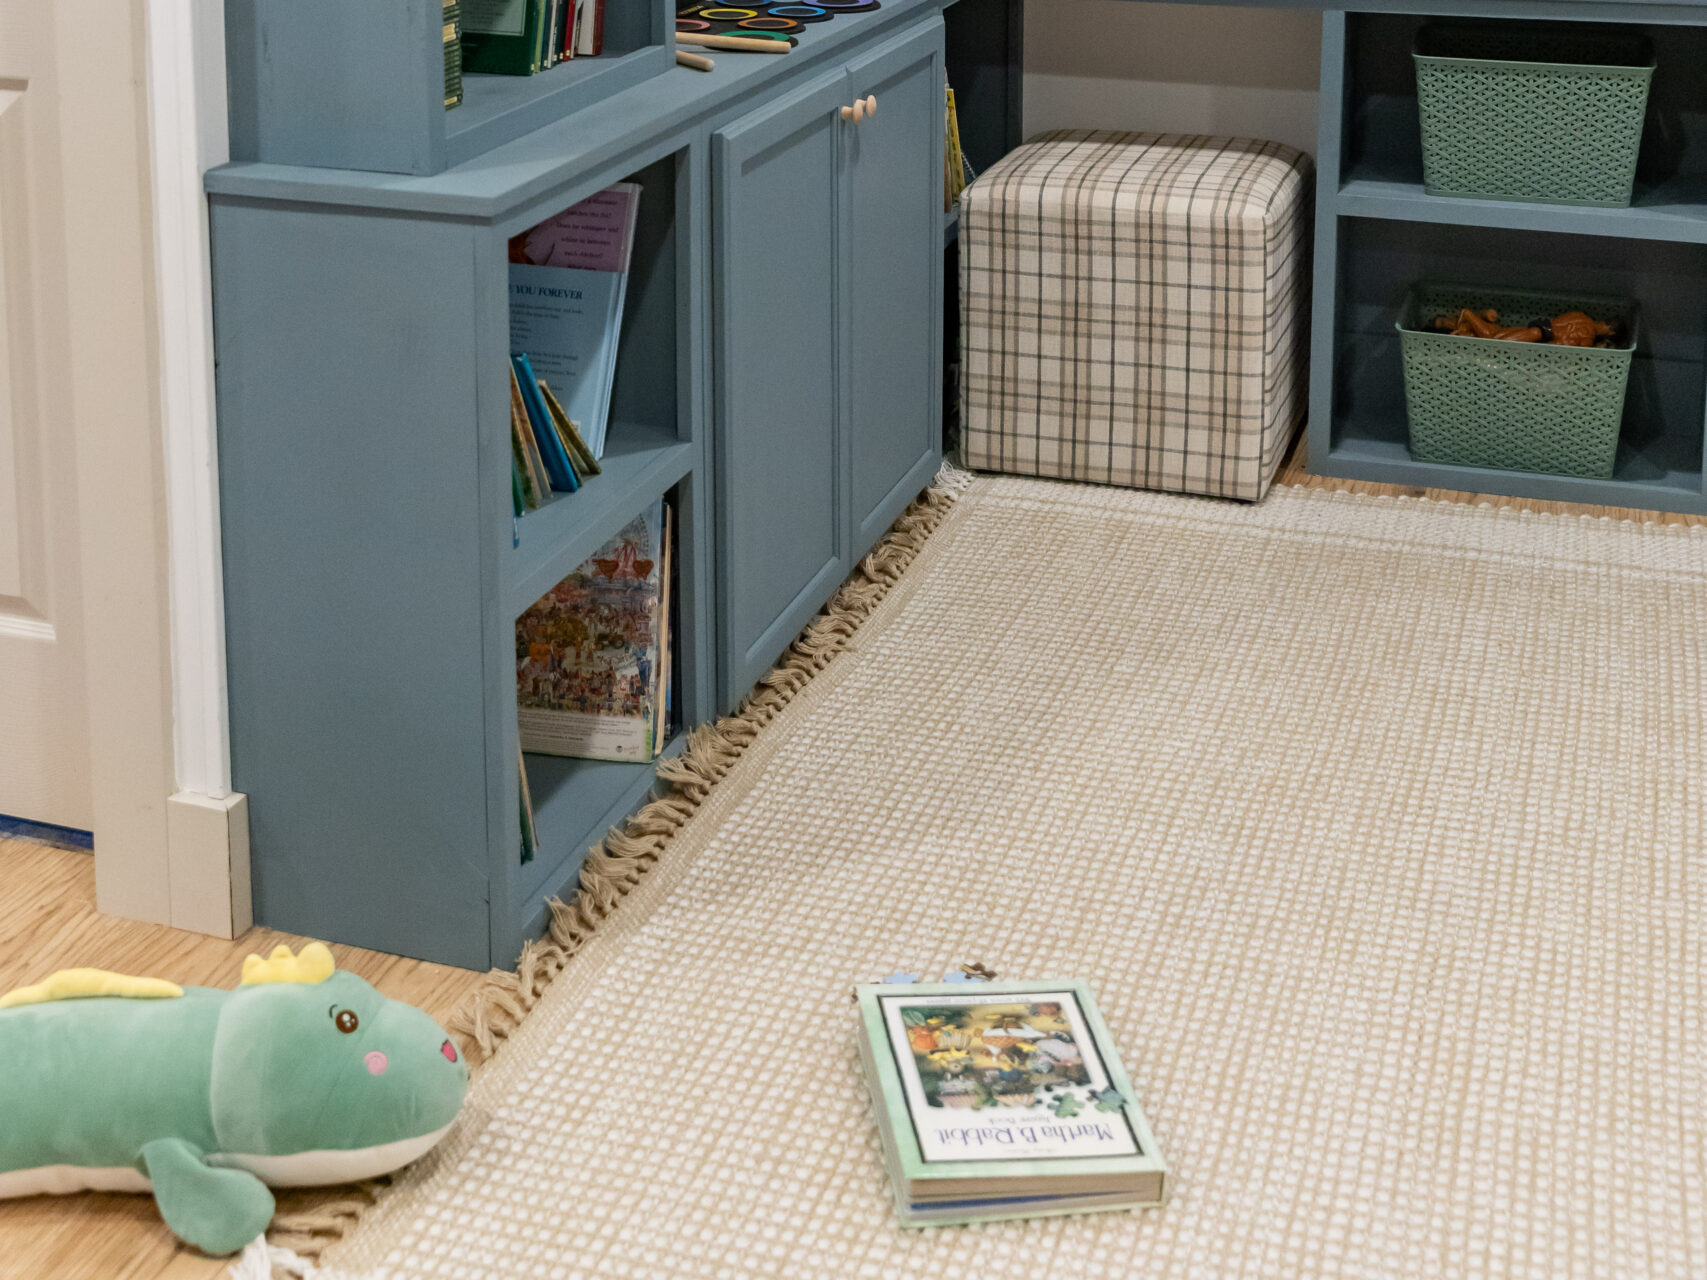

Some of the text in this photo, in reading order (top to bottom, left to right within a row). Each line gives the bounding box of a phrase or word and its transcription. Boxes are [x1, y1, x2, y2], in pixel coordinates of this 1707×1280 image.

[515, 284, 584, 300] YOU FOREVER
[937, 1127, 1016, 1146] Rabbit
[1041, 1123, 1115, 1144] Martha
